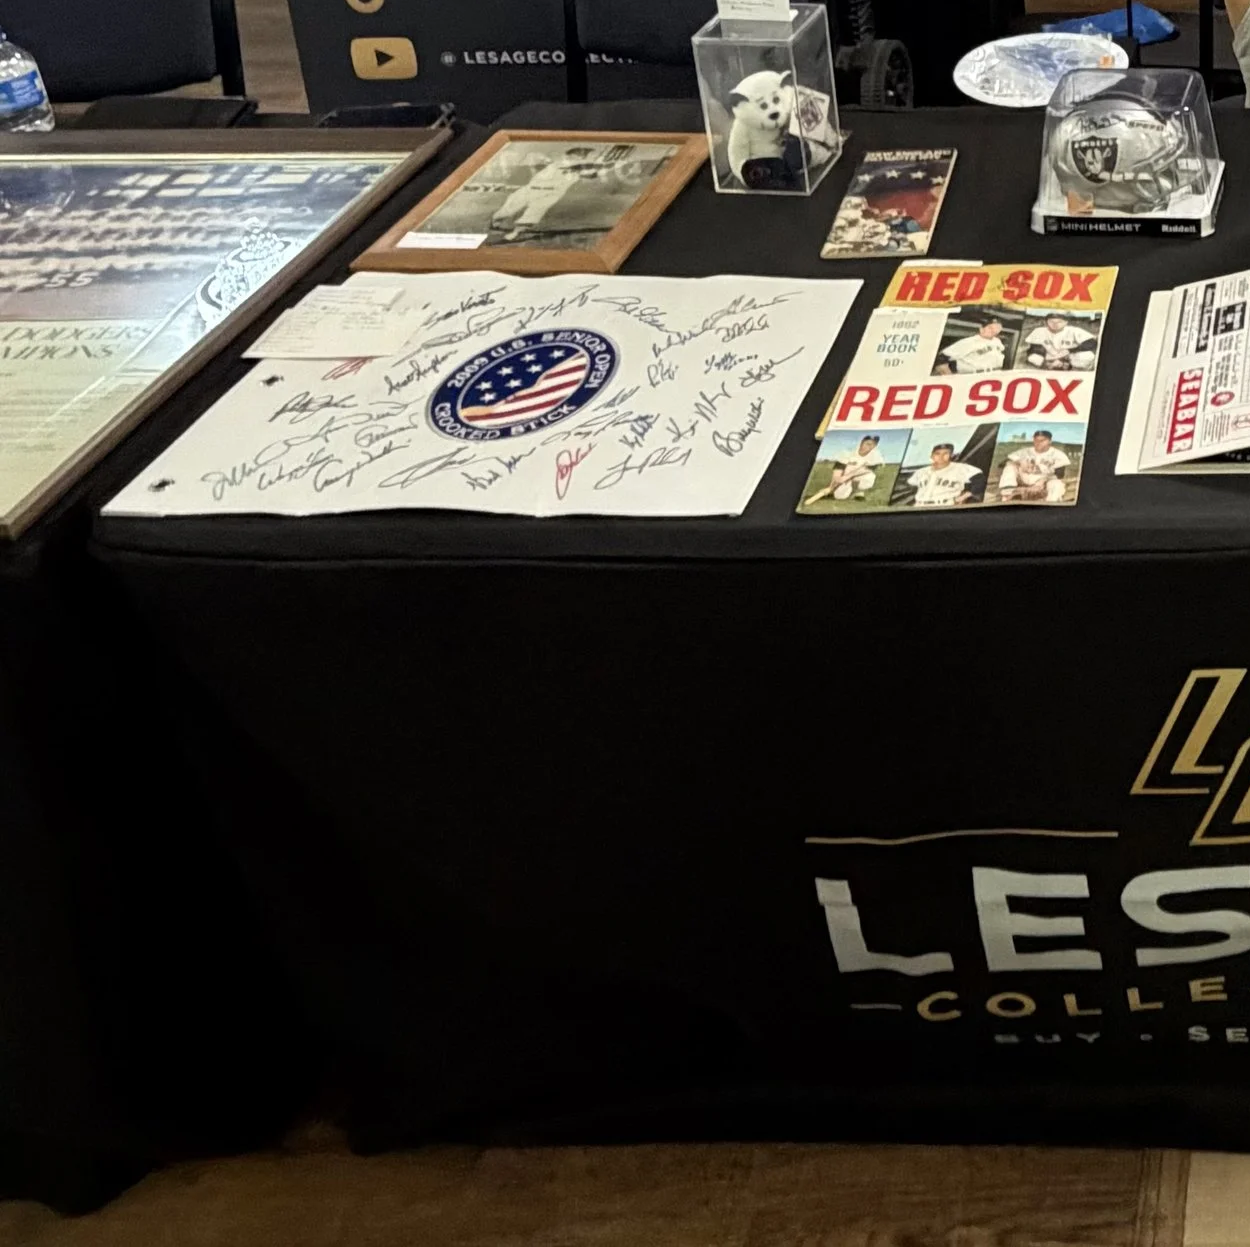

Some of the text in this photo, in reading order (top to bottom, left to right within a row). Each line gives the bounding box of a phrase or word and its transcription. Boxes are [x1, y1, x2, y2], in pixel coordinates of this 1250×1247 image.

[896, 269, 1101, 303] RED SOX
[876, 343, 918, 354] BOOK
[883, 334, 920, 344] YEAR
[447, 356, 490, 389] 2009
[541, 331, 607, 358] SENIOR
[584, 354, 611, 389] OPEN
[836, 377, 1083, 422] RED SOX
[434, 402, 577, 440] CROOKED STICK
